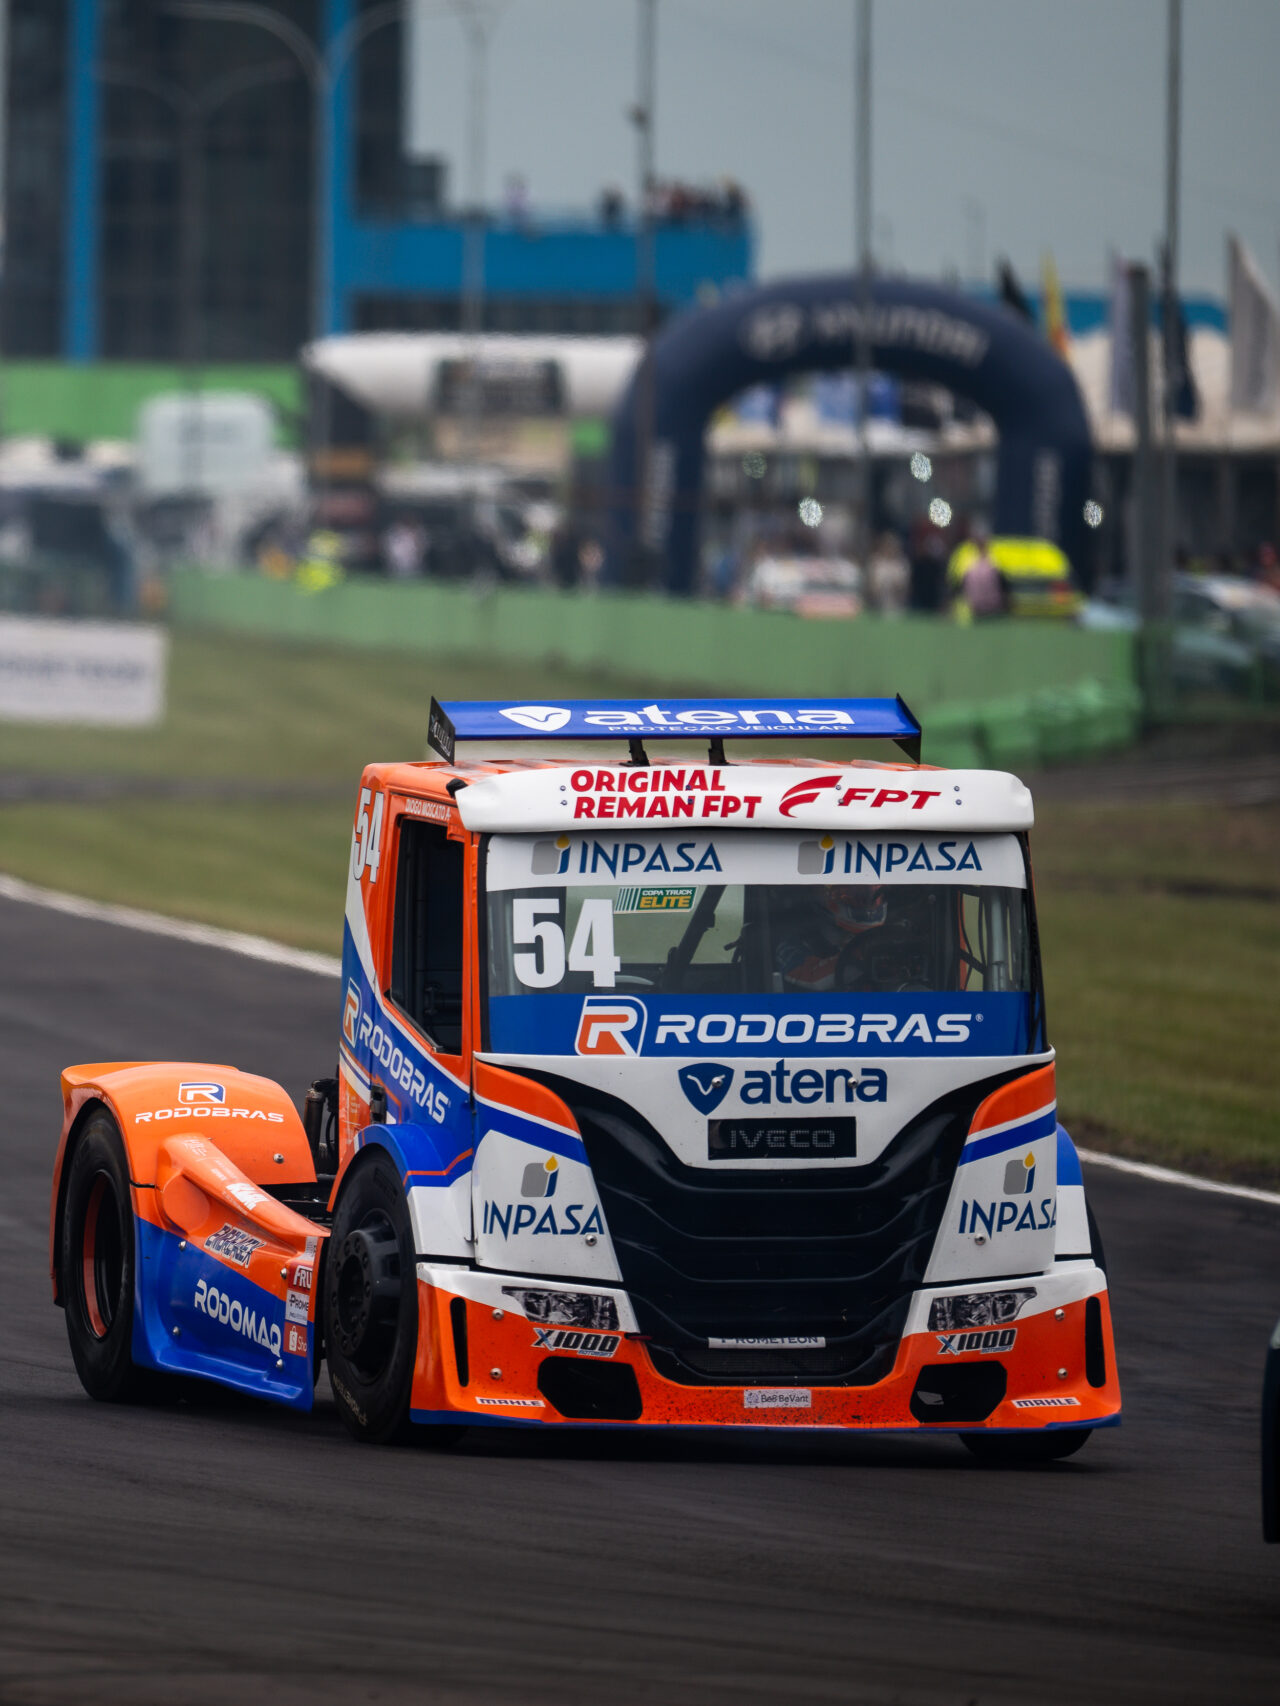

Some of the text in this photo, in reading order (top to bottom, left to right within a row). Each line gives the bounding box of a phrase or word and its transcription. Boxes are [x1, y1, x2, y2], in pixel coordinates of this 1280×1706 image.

[583, 704, 856, 726] atena
[570, 769, 726, 792] ORIGINAL
[573, 795, 762, 819] REMAN FPT
[838, 787, 942, 811] FPT
[353, 786, 385, 884] 54
[579, 840, 723, 879] INPASA
[844, 840, 983, 880] INPASA
[639, 896, 692, 909] ELITE
[513, 898, 621, 989] 54
[359, 1012, 449, 1124] RODOBRAS
[739, 1059, 888, 1105] atena
[135, 1107, 284, 1124] RODOBRAS
[730, 1129, 836, 1148] IVECO
[482, 1200, 605, 1241] INPASA
[194, 1279, 282, 1357] RODOMAQ
[532, 1328, 620, 1352] X1000
[936, 1328, 1017, 1355] X1000
[480, 1398, 544, 1407] MAHLE
[1016, 1398, 1080, 1407] MAHLE
